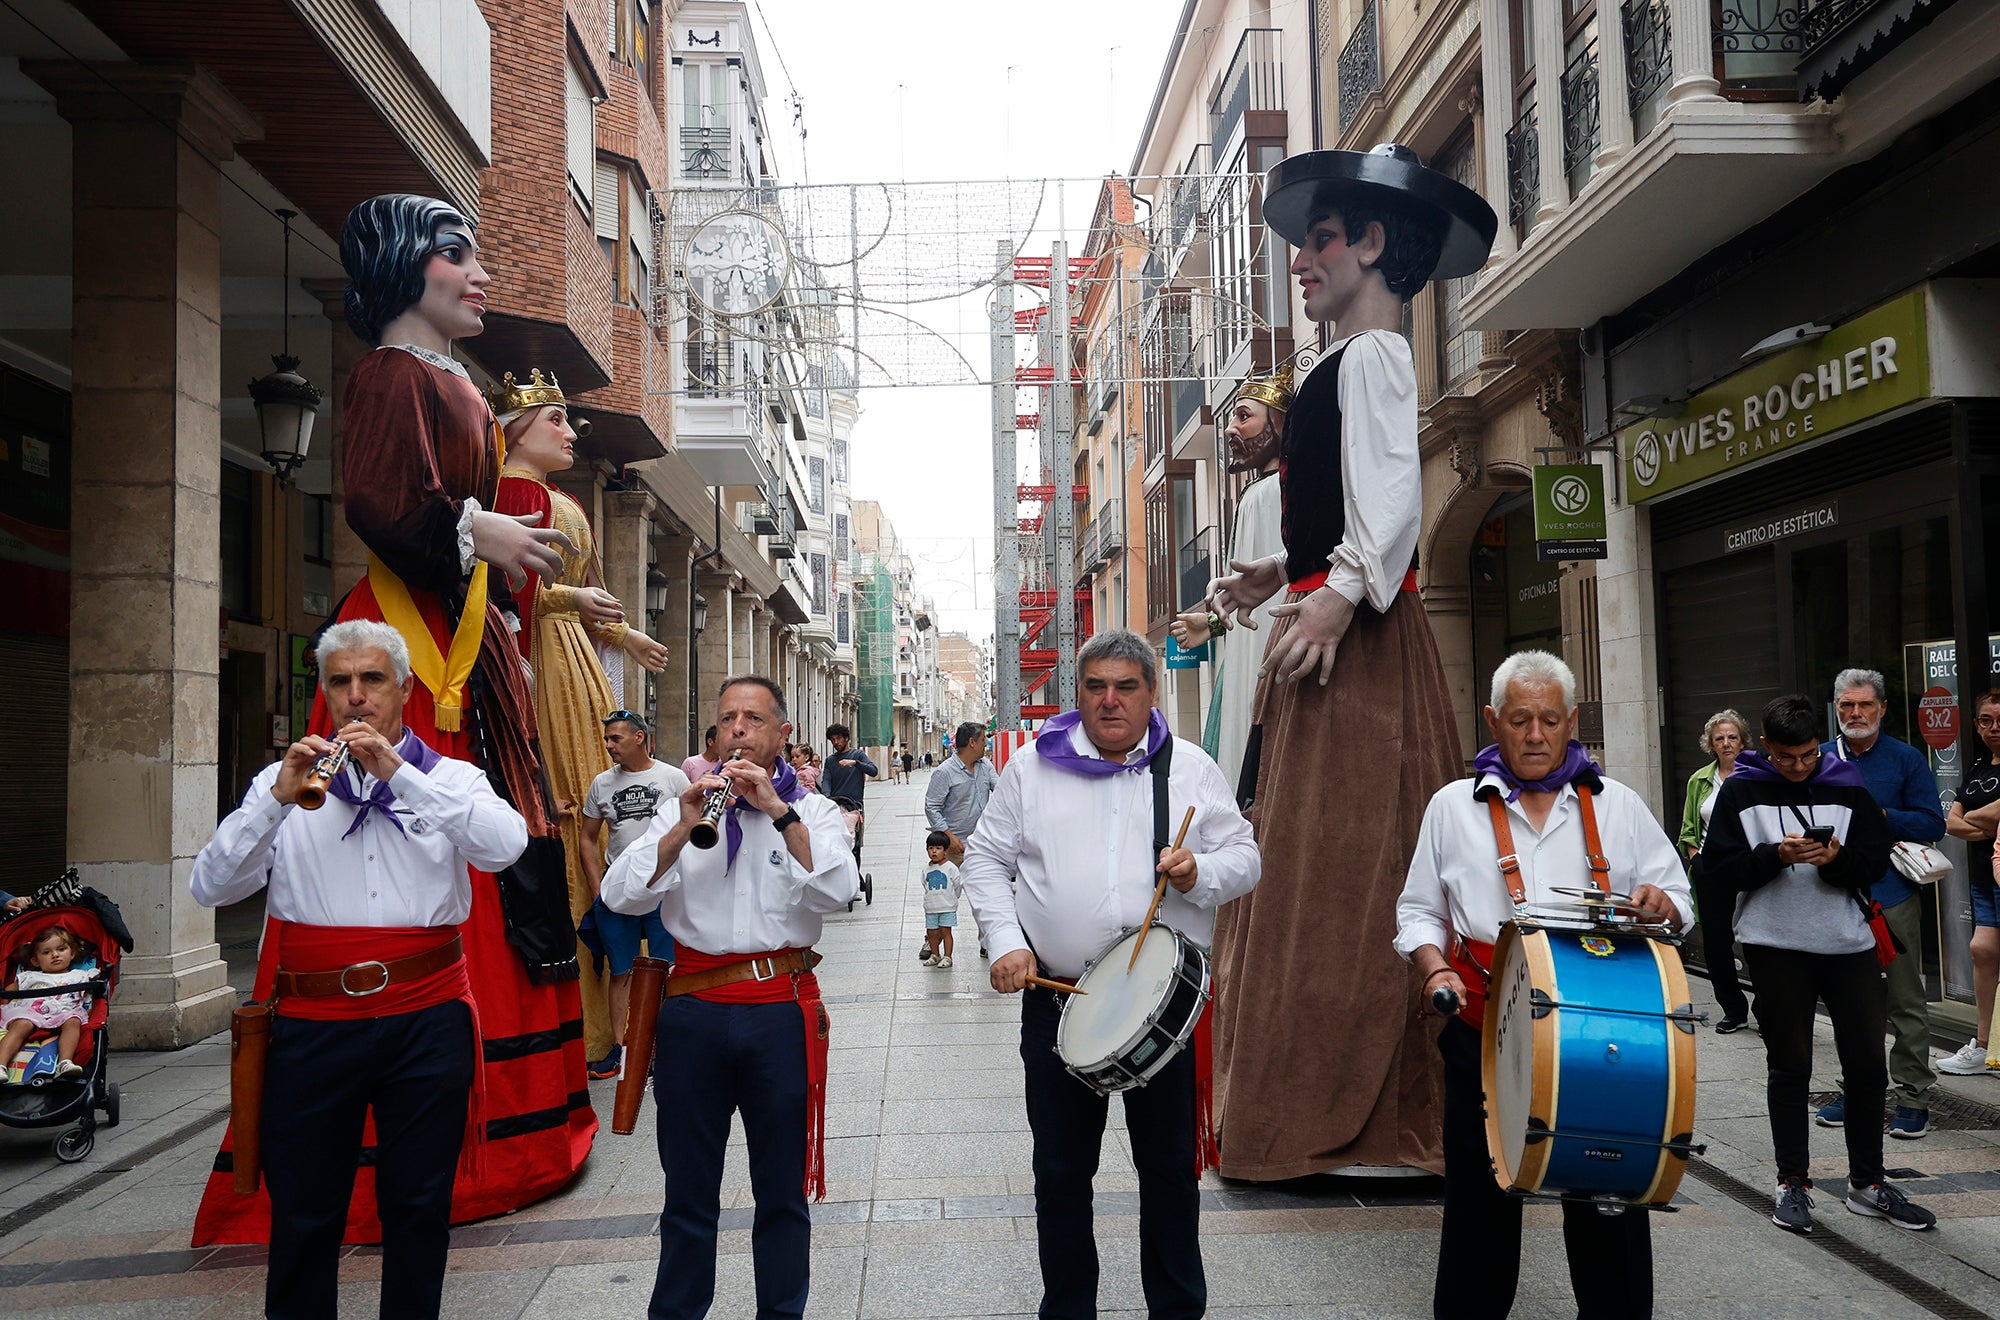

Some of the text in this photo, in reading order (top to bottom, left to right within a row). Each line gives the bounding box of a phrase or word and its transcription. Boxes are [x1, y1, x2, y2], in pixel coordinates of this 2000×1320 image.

[1664, 337, 1898, 462] YVES ROCHER
[1726, 415, 1814, 462] FRANCE
[1543, 522, 1564, 530] YVES
[1727, 508, 1834, 549] CENTRO DE ESTÉTICA
[1519, 579, 1558, 602] OFICINA DE
[1170, 654, 1198, 662] cajamar
[1929, 648, 1956, 663] RALE
[982, 638, 990, 708] FARMACIA
[1930, 664, 1950, 678] DEL
[1923, 698, 1953, 706] CAPILARES
[1926, 708, 1951, 728] 3x2
[626, 791, 645, 801] NOJA
